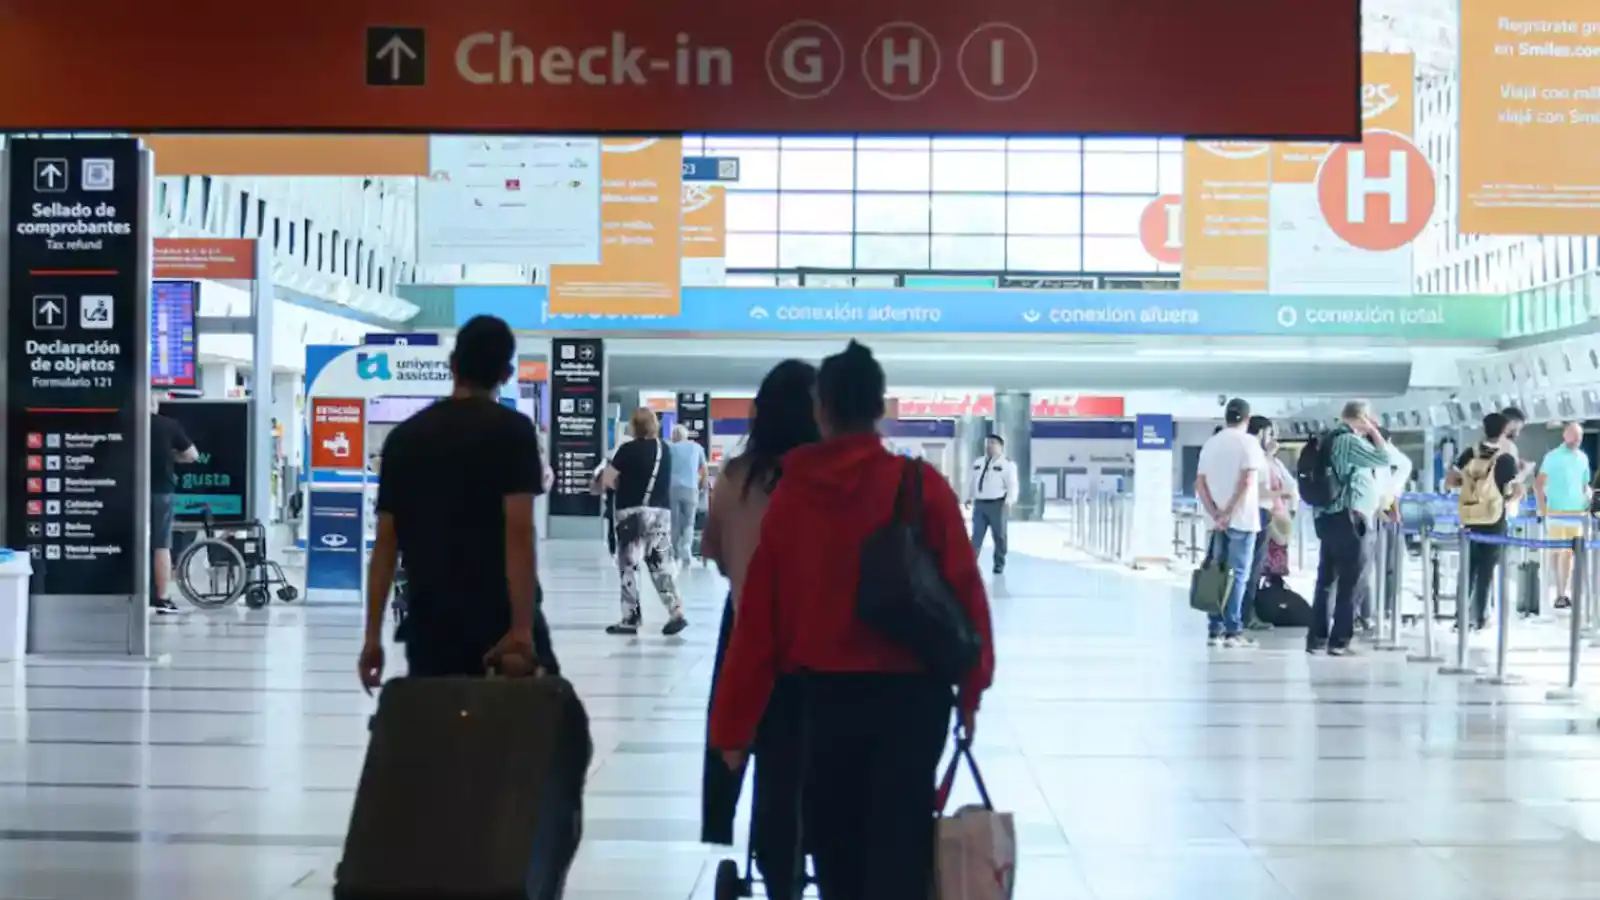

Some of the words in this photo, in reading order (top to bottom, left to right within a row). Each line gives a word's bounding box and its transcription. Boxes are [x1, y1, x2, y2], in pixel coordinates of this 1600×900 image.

[455, 31, 733, 85] Check-in
[783, 36, 823, 83] G
[882, 37, 922, 85] H
[990, 39, 1005, 85] I
[1494, 45, 1514, 56] en
[1541, 88, 1570, 99] con
[1537, 112, 1563, 123] con
[1346, 149, 1408, 224] H
[32, 202, 92, 218] Sellado
[95, 202, 116, 218] de
[16, 219, 131, 238] comprobantes
[46, 239, 65, 250] Tax
[66, 239, 103, 250] refund
[776, 301, 862, 321] conexión
[867, 303, 942, 322] adentro
[1305, 306, 1395, 324] conexión
[25, 338, 120, 355] Declaración
[30, 356, 52, 372] de
[54, 356, 115, 375] objetos
[32, 376, 91, 388] Formulario
[93, 376, 112, 388] 121
[182, 473, 231, 489] gusta
